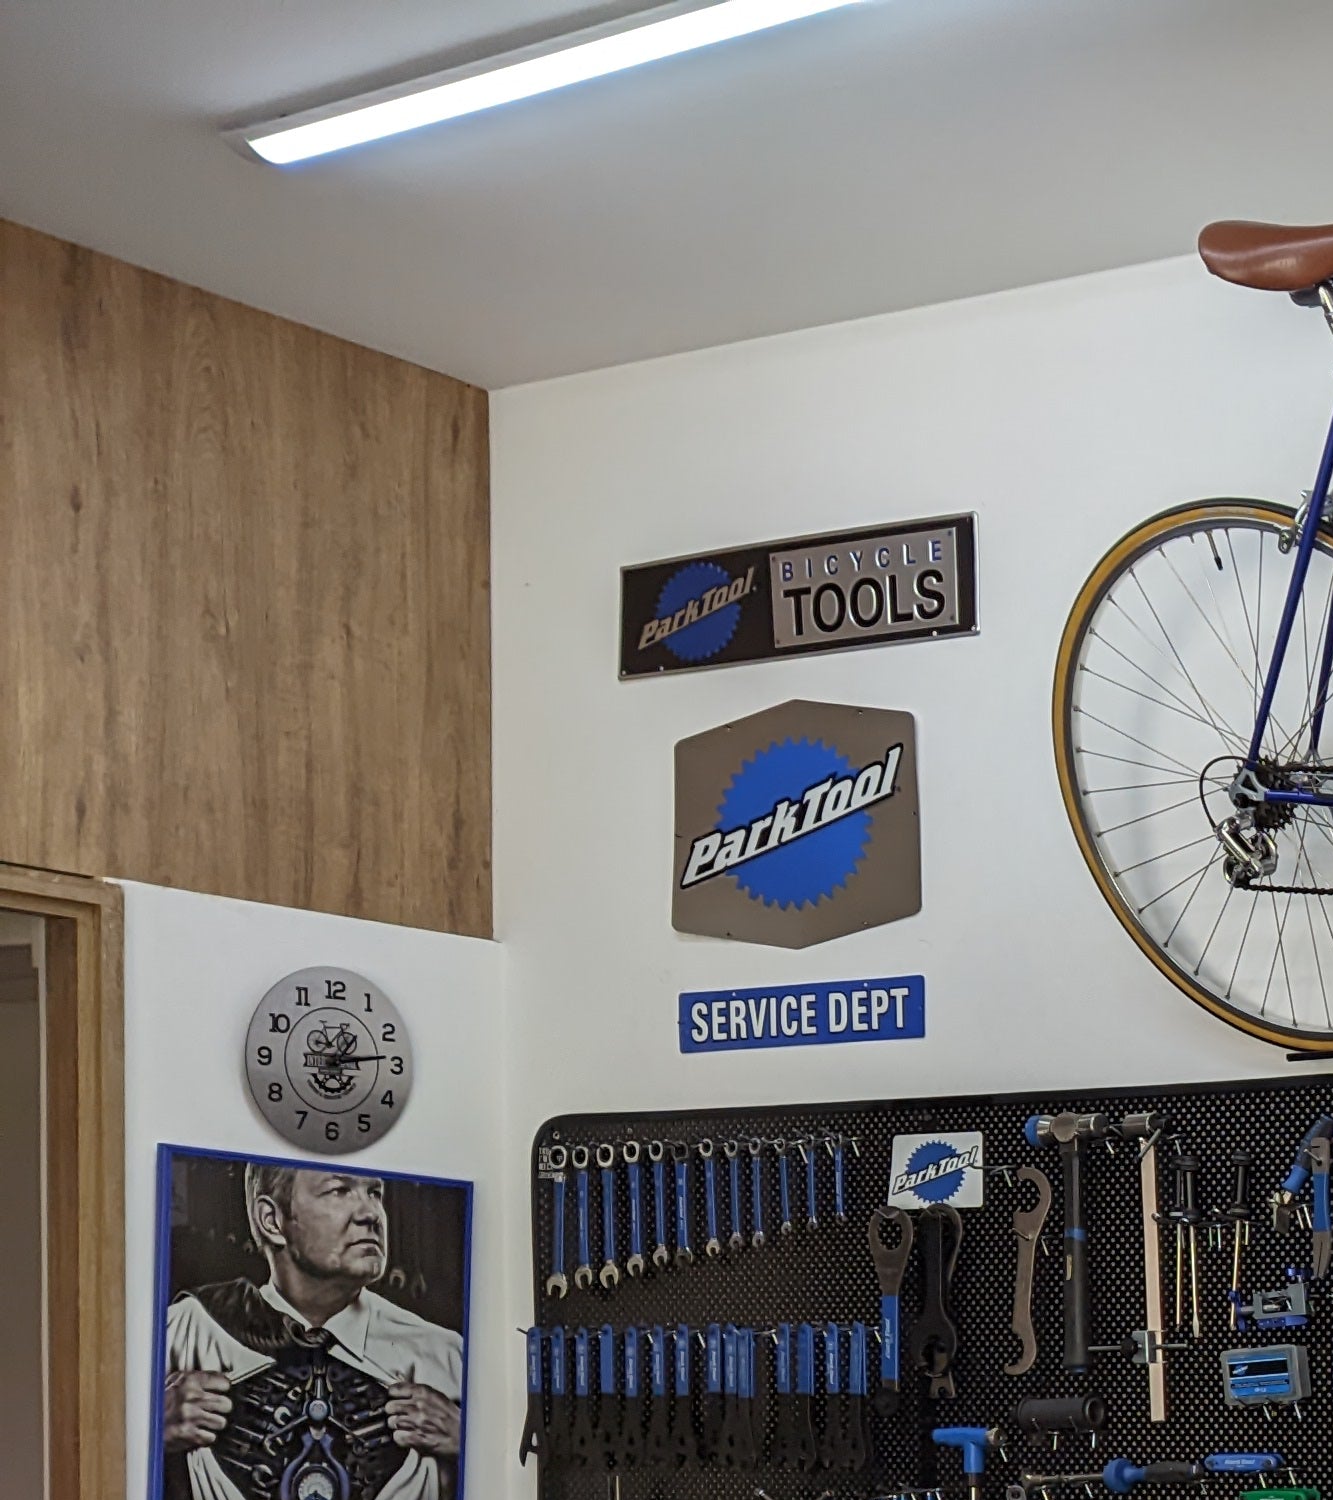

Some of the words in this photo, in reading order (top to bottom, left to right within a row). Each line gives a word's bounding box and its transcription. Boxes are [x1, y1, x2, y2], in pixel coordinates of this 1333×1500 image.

[781, 539, 944, 583] BICYCLE
[639, 566, 756, 650] ParkTool
[783, 568, 946, 636] TOOLS
[681, 743, 904, 888] ParkTool
[295, 986, 310, 1007] 11
[325, 980, 346, 1000] 12
[364, 993, 372, 1012] 1
[269, 1013, 290, 1033] 10
[691, 993, 817, 1043] SERVICE
[828, 987, 910, 1033] DEPT
[382, 1023, 395, 1042] 2
[257, 1046, 272, 1065] 9
[390, 1056, 403, 1075] 3
[268, 1083, 283, 1102] 8
[381, 1090, 394, 1108] 4
[295, 1110, 308, 1129] 7
[357, 1114, 371, 1132] 5
[325, 1122, 339, 1141] 6
[892, 1145, 979, 1196] ParkTool
